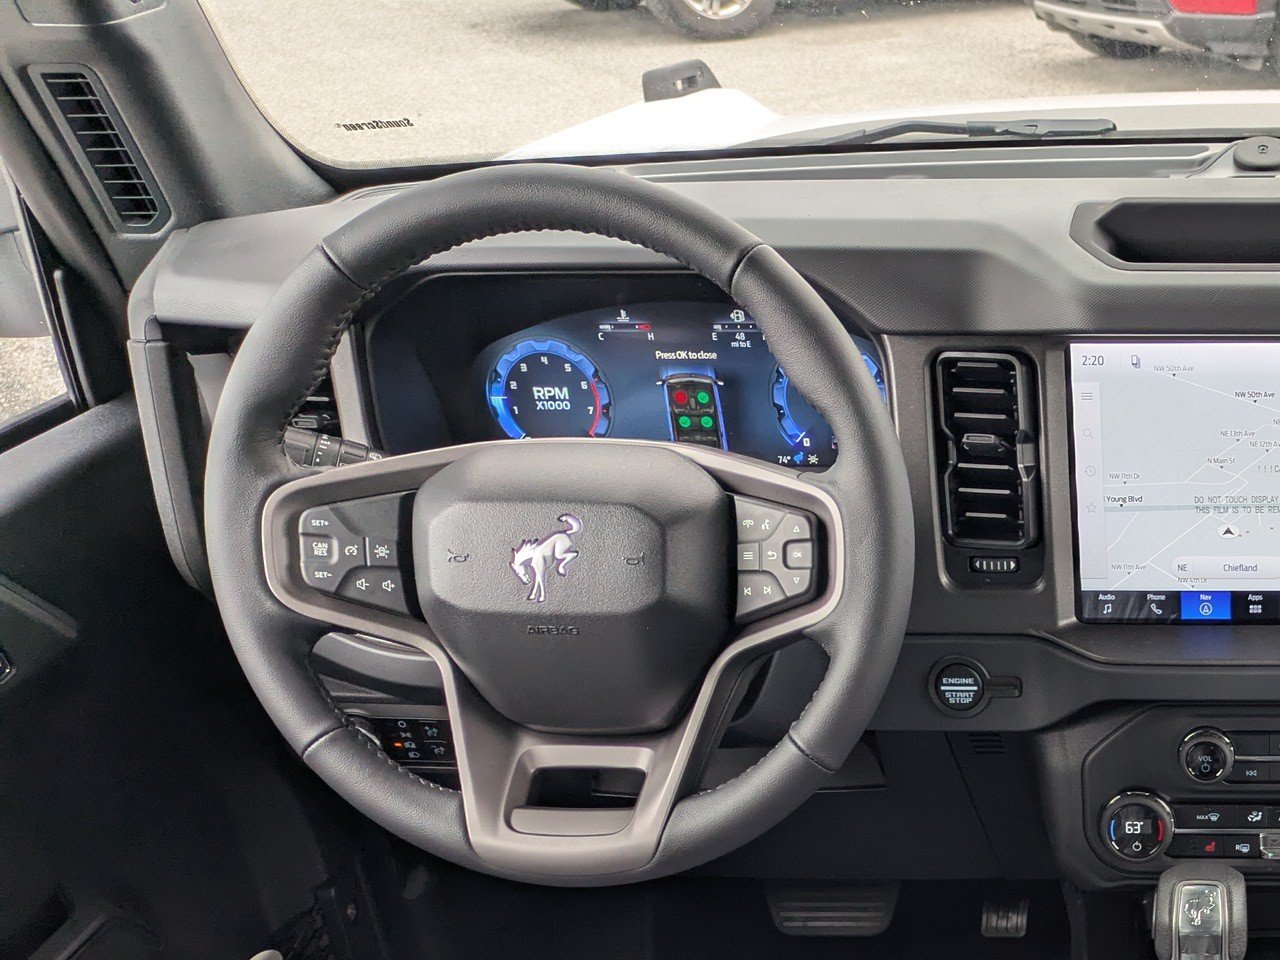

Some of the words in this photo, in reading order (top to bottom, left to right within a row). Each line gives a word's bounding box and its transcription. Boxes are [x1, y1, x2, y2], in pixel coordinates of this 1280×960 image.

[598, 332, 604, 340] C
[647, 332, 654, 340] H
[655, 351, 676, 359] Press
[676, 351, 688, 359] OK
[689, 351, 697, 359] to
[697, 351, 717, 359] close
[1082, 355, 1104, 366] 2:20
[520, 364, 527, 372] 3
[565, 364, 572, 372] 5
[510, 381, 517, 389] 2
[532, 387, 569, 400] RPM
[536, 401, 570, 410] X1000
[1248, 594, 1263, 602] Apps
[528, 626, 579, 635] AIRBAG
